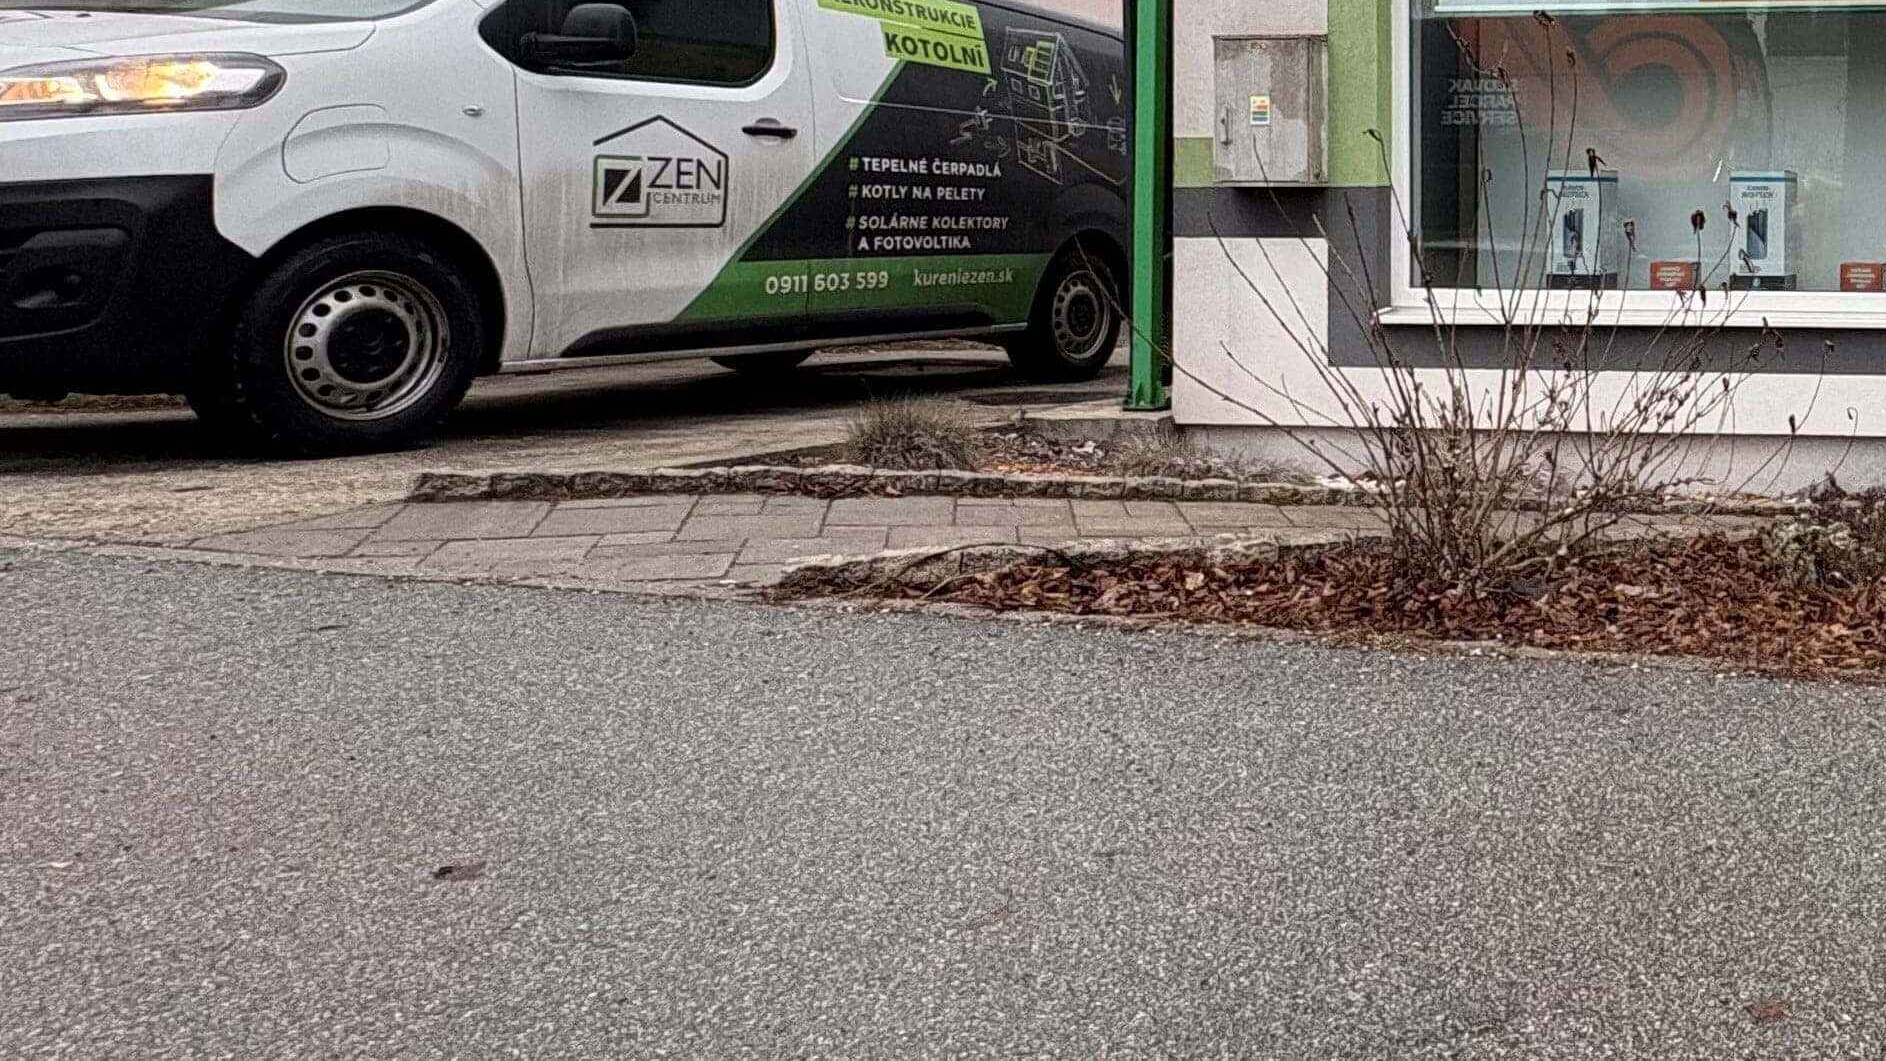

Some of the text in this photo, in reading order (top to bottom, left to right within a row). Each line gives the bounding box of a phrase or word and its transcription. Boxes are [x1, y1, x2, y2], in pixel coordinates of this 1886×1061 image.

[884, 31, 984, 68] KOTOLNÍ
[647, 156, 721, 190] ZEN
[932, 158, 1001, 177] ČERPADLÁ
[653, 192, 721, 204] CENTRUM
[912, 186, 932, 200] NA
[937, 187, 985, 201] PELETY
[932, 216, 1009, 230] KOLEKTORY
[858, 236, 971, 251] A FOTOVOLTIKA
[765, 271, 889, 294] 0911 603 599
